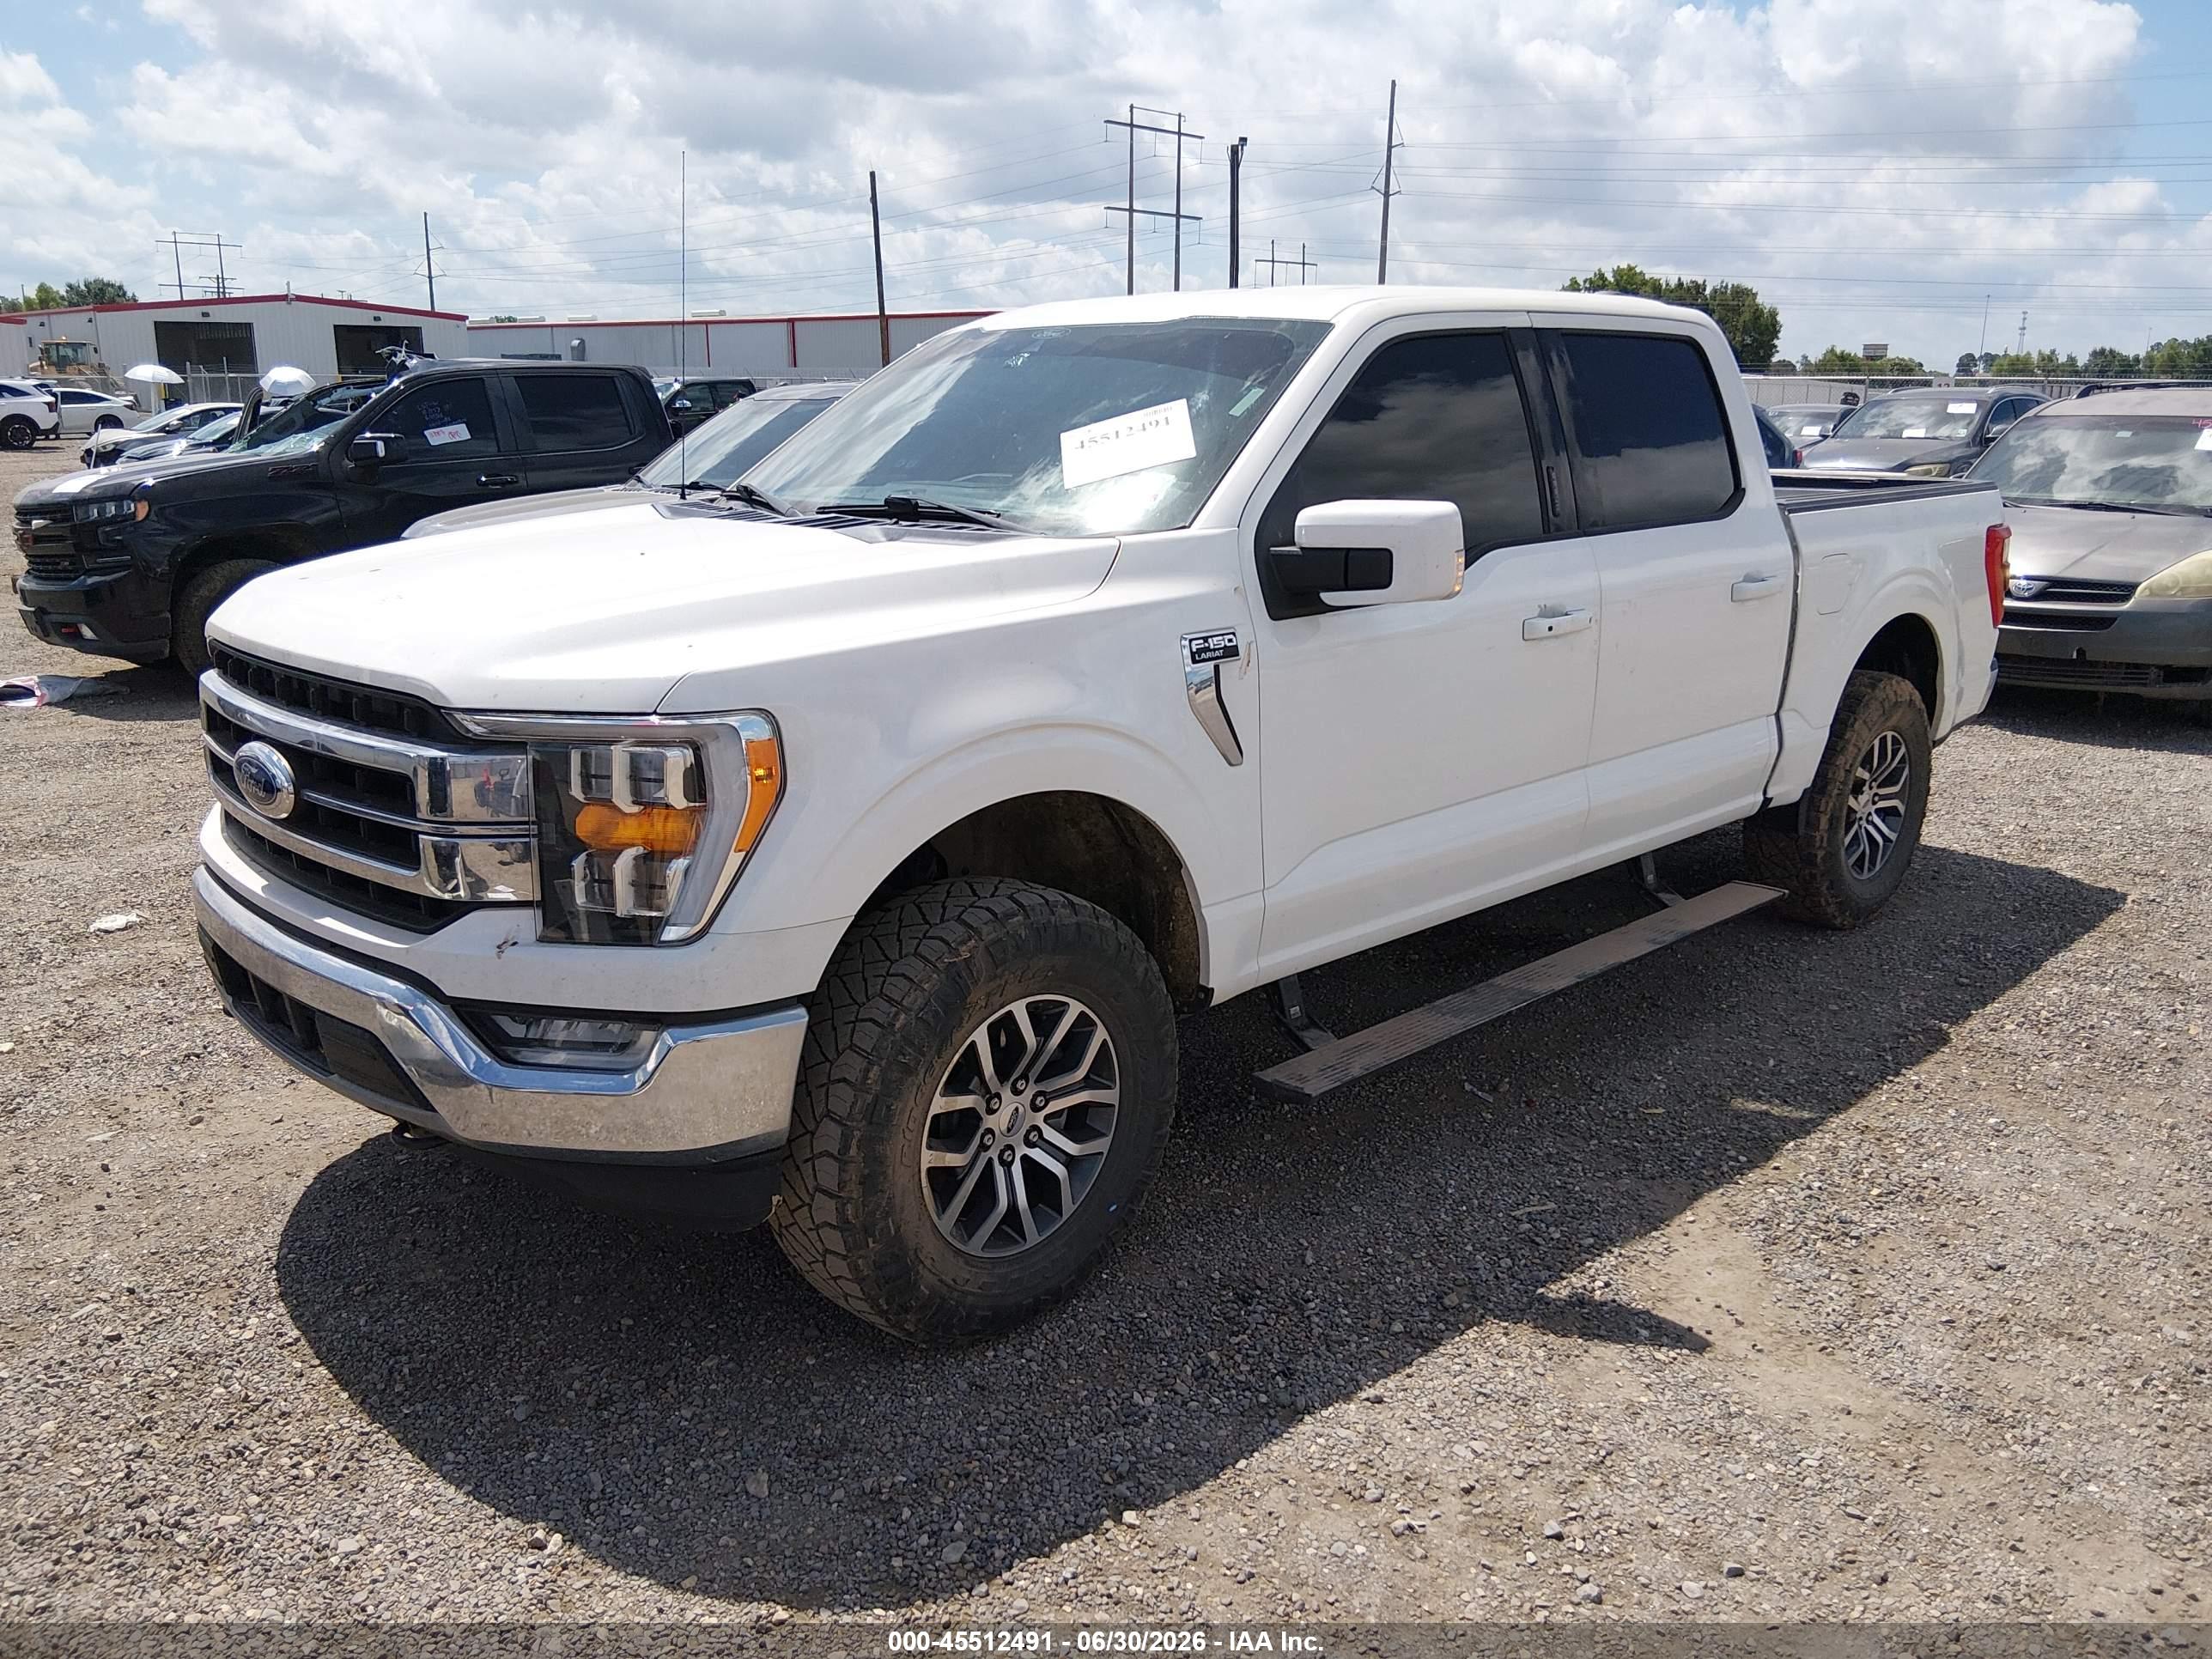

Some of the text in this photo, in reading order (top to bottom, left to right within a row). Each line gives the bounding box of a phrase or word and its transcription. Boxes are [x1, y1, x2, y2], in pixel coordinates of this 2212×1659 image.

[1075, 416, 1170, 449] 45512491
[1191, 635, 1237, 652] F-150
[1195, 650, 1224, 659] LARIAT
[240, 762, 268, 798] Ford
